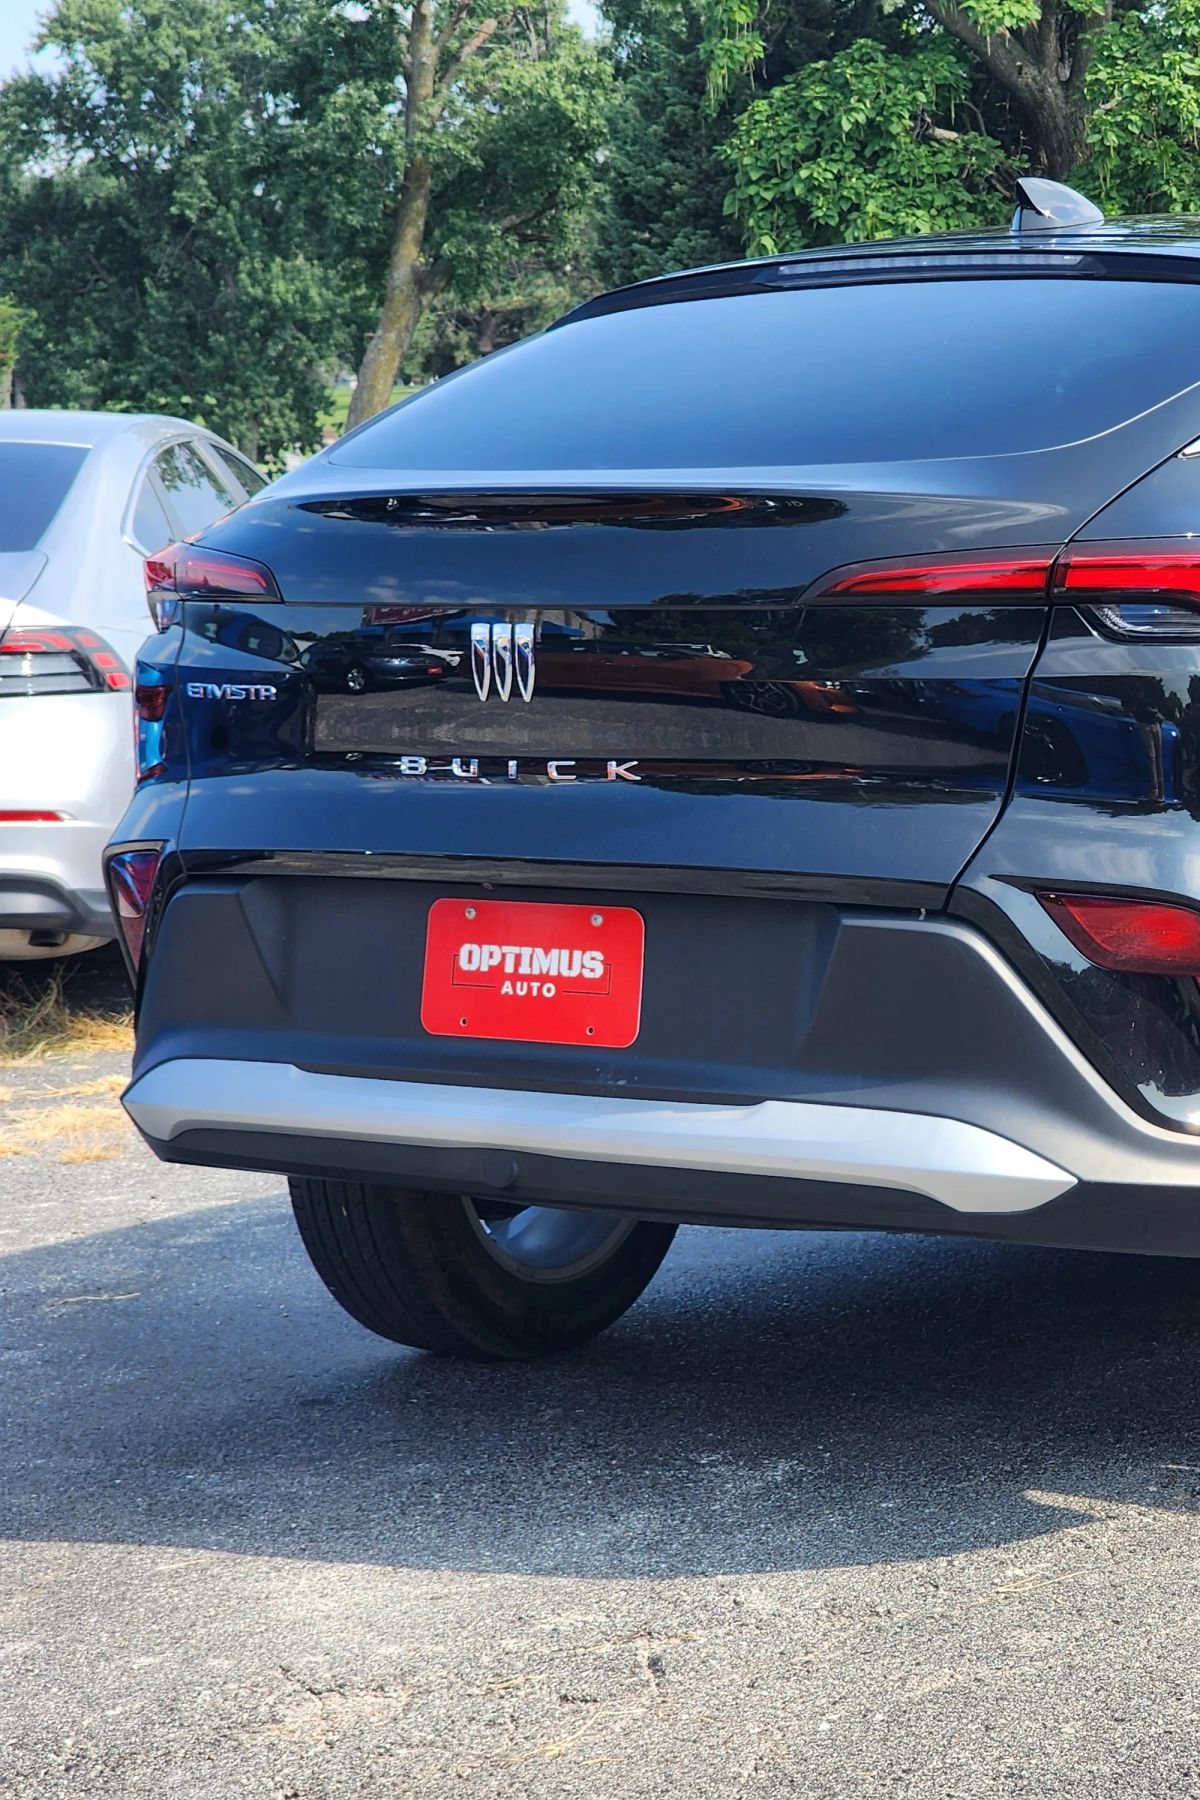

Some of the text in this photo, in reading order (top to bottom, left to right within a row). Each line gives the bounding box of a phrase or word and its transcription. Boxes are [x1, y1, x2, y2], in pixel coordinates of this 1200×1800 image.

[400, 756, 642, 781] BUICK
[459, 943, 604, 979] OPTIMUS
[501, 980, 556, 998] AUTO
